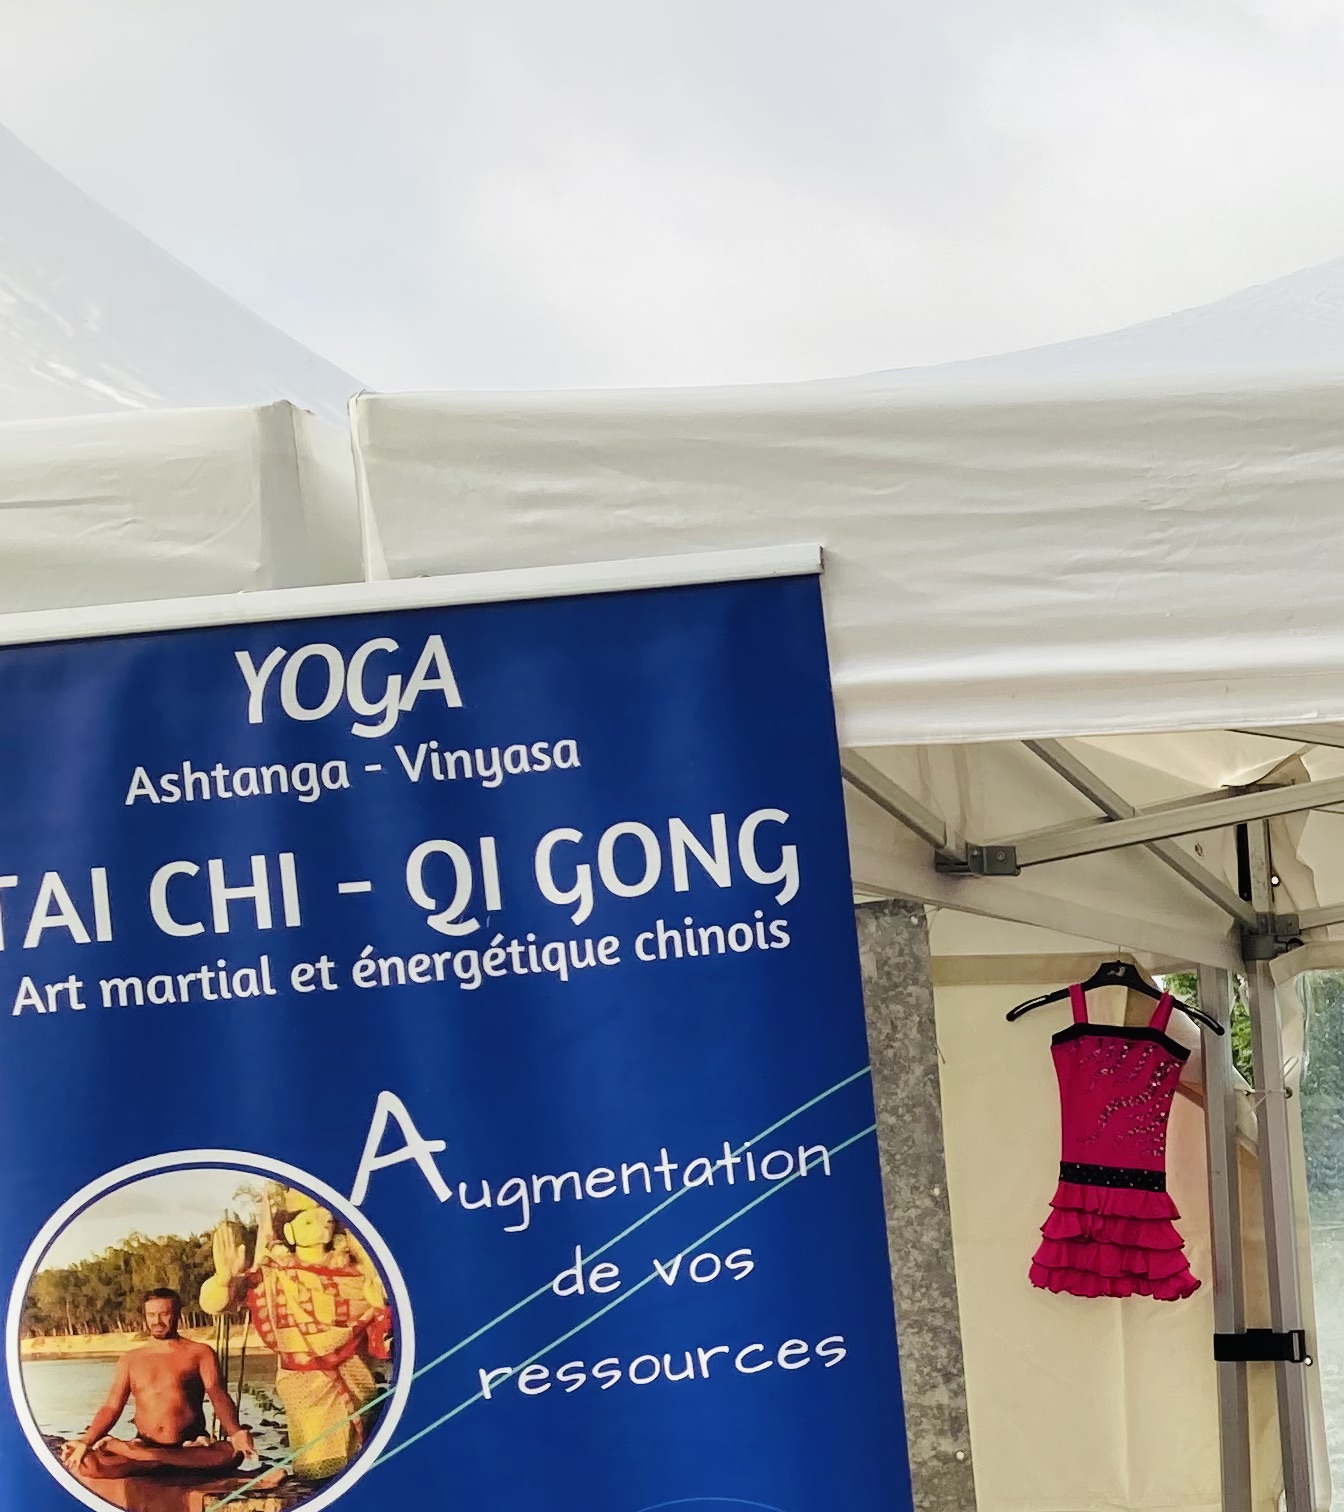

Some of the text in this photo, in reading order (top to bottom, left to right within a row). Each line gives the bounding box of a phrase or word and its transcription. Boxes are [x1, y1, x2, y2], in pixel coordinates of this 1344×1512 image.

[235, 633, 462, 738] YOGA
[125, 752, 349, 807] Ashtanga
[396, 736, 580, 789] Vinyasa
[150, 852, 301, 939] CHI
[338, 880, 372, 894] -
[405, 835, 502, 936] QI
[535, 807, 800, 906] GONG
[12, 908, 791, 1016] Art martial et énergétique chinois
[350, 1089, 831, 1232] Augmentation
[552, 1242, 755, 1299] de vos
[477, 1330, 848, 1400] ressources
